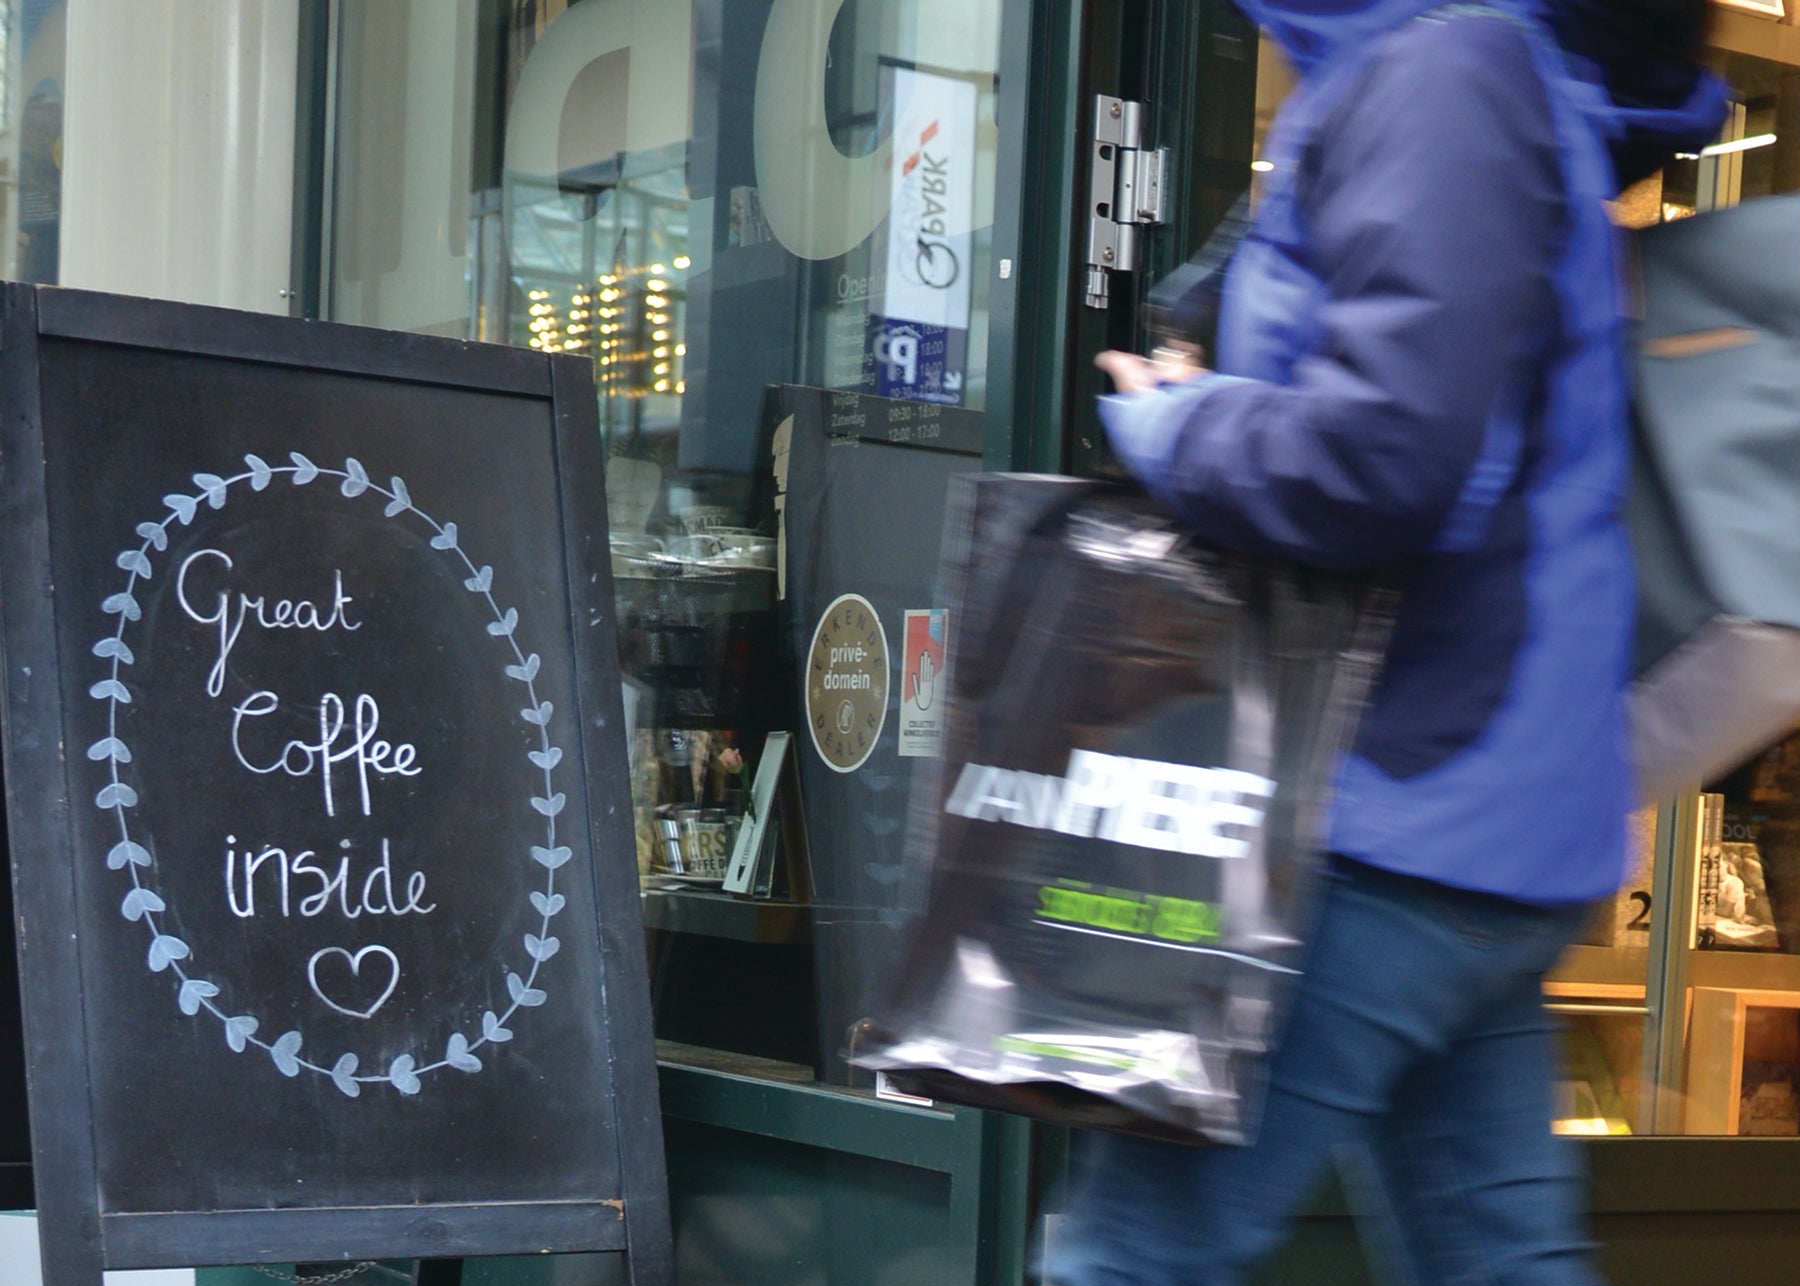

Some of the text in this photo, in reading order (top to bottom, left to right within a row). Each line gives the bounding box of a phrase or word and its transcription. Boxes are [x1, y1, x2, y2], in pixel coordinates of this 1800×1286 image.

[176, 548, 362, 699] Great
[830, 641, 868, 668] privé-
[824, 669, 870, 690] domein
[232, 690, 424, 817] Coffee
[225, 833, 437, 920] inside
[1627, 890, 1652, 931] 2
